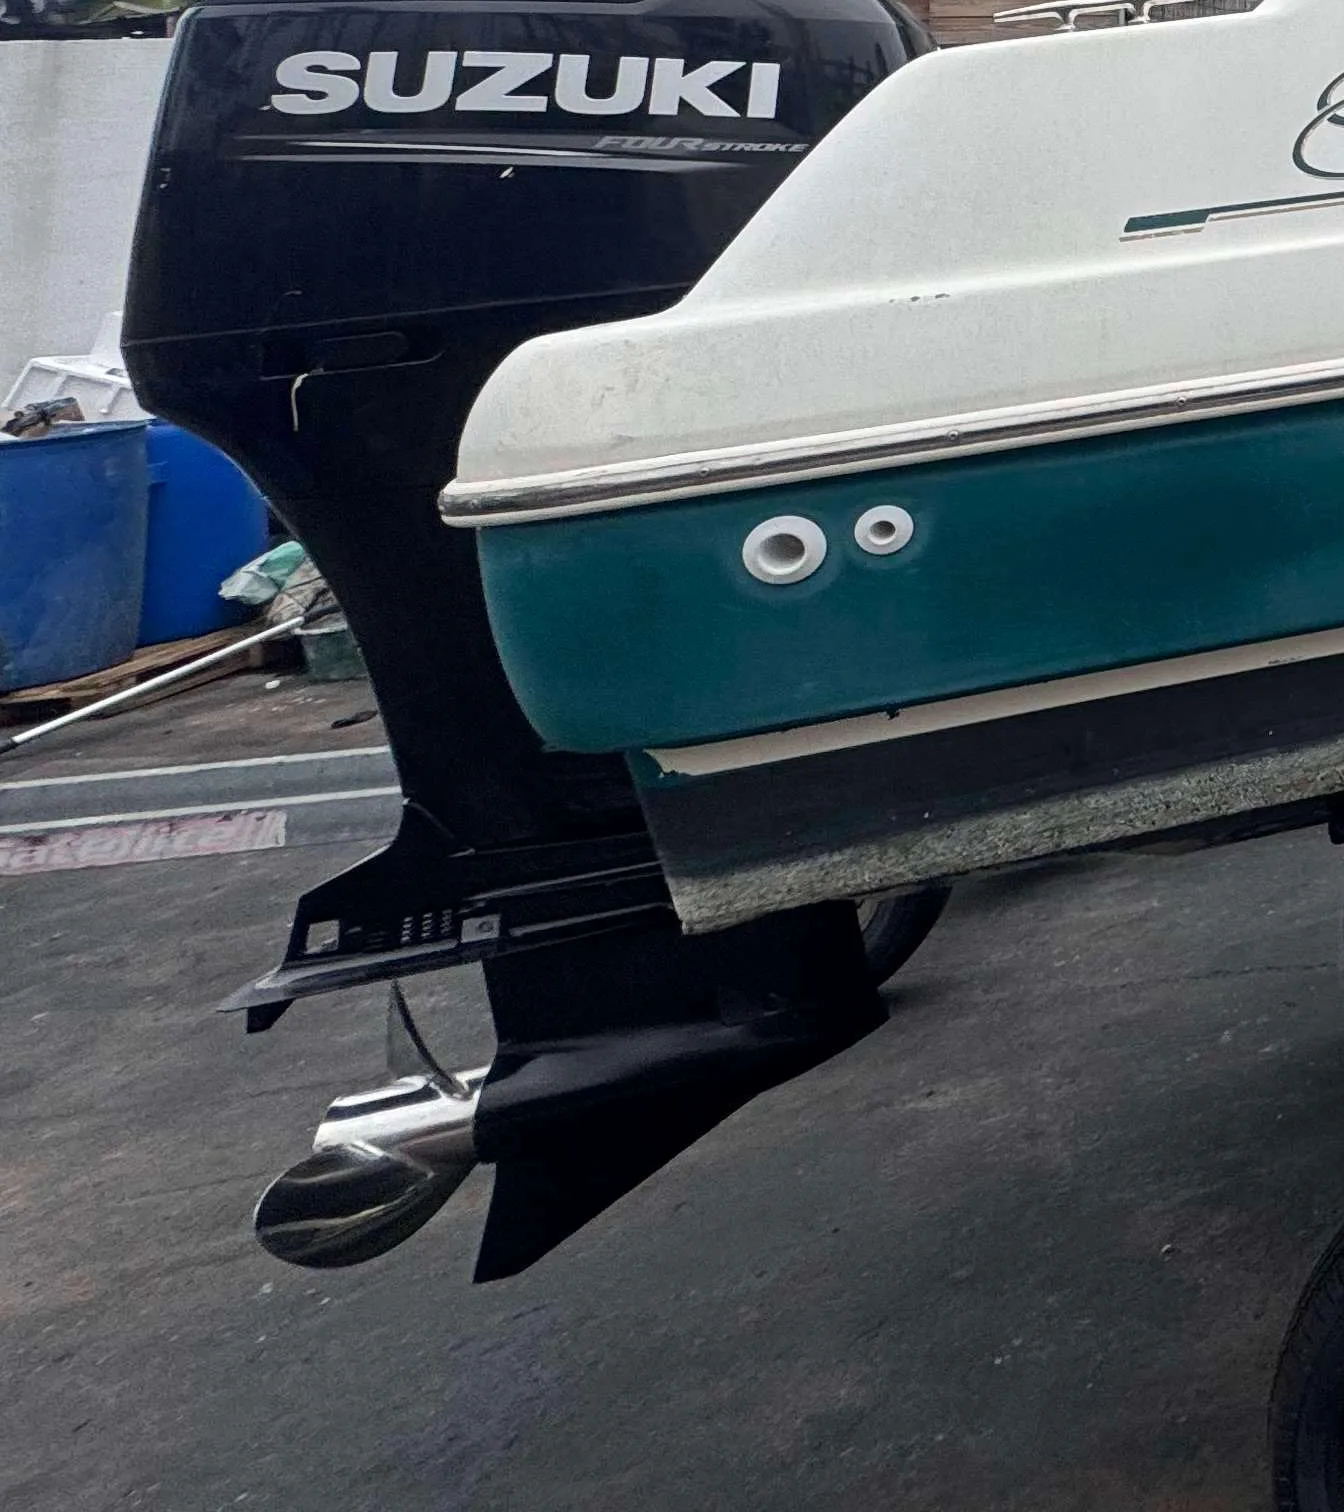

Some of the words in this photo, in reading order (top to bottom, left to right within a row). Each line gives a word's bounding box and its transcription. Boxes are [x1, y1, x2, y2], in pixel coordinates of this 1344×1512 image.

[270, 50, 781, 120] SUZUKI
[595, 136, 704, 152] FOUR
[702, 143, 809, 153] STROKE
